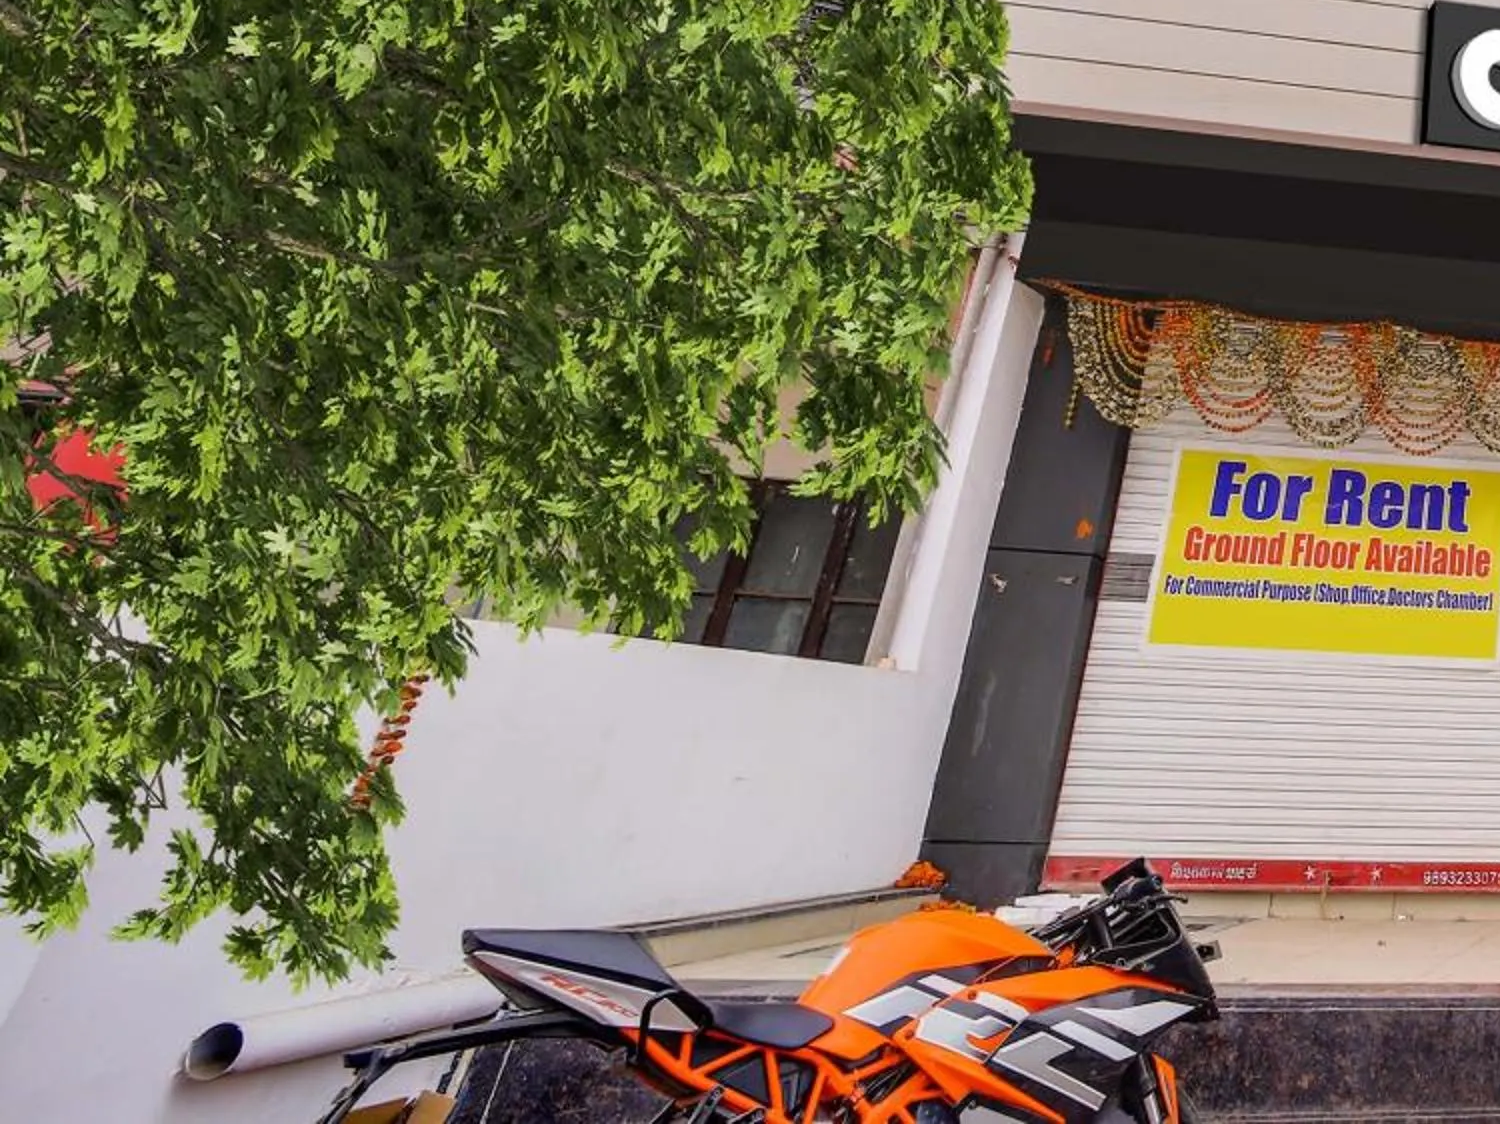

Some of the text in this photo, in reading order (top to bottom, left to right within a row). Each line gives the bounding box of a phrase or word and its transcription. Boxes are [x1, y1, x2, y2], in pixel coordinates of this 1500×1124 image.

[1209, 460, 1471, 533] For Rent
[1183, 525, 1491, 578] Ground Floor Available
[1165, 575, 1184, 593] For
[1185, 576, 1261, 598] Commercial
[1261, 580, 1312, 602] Purpose
